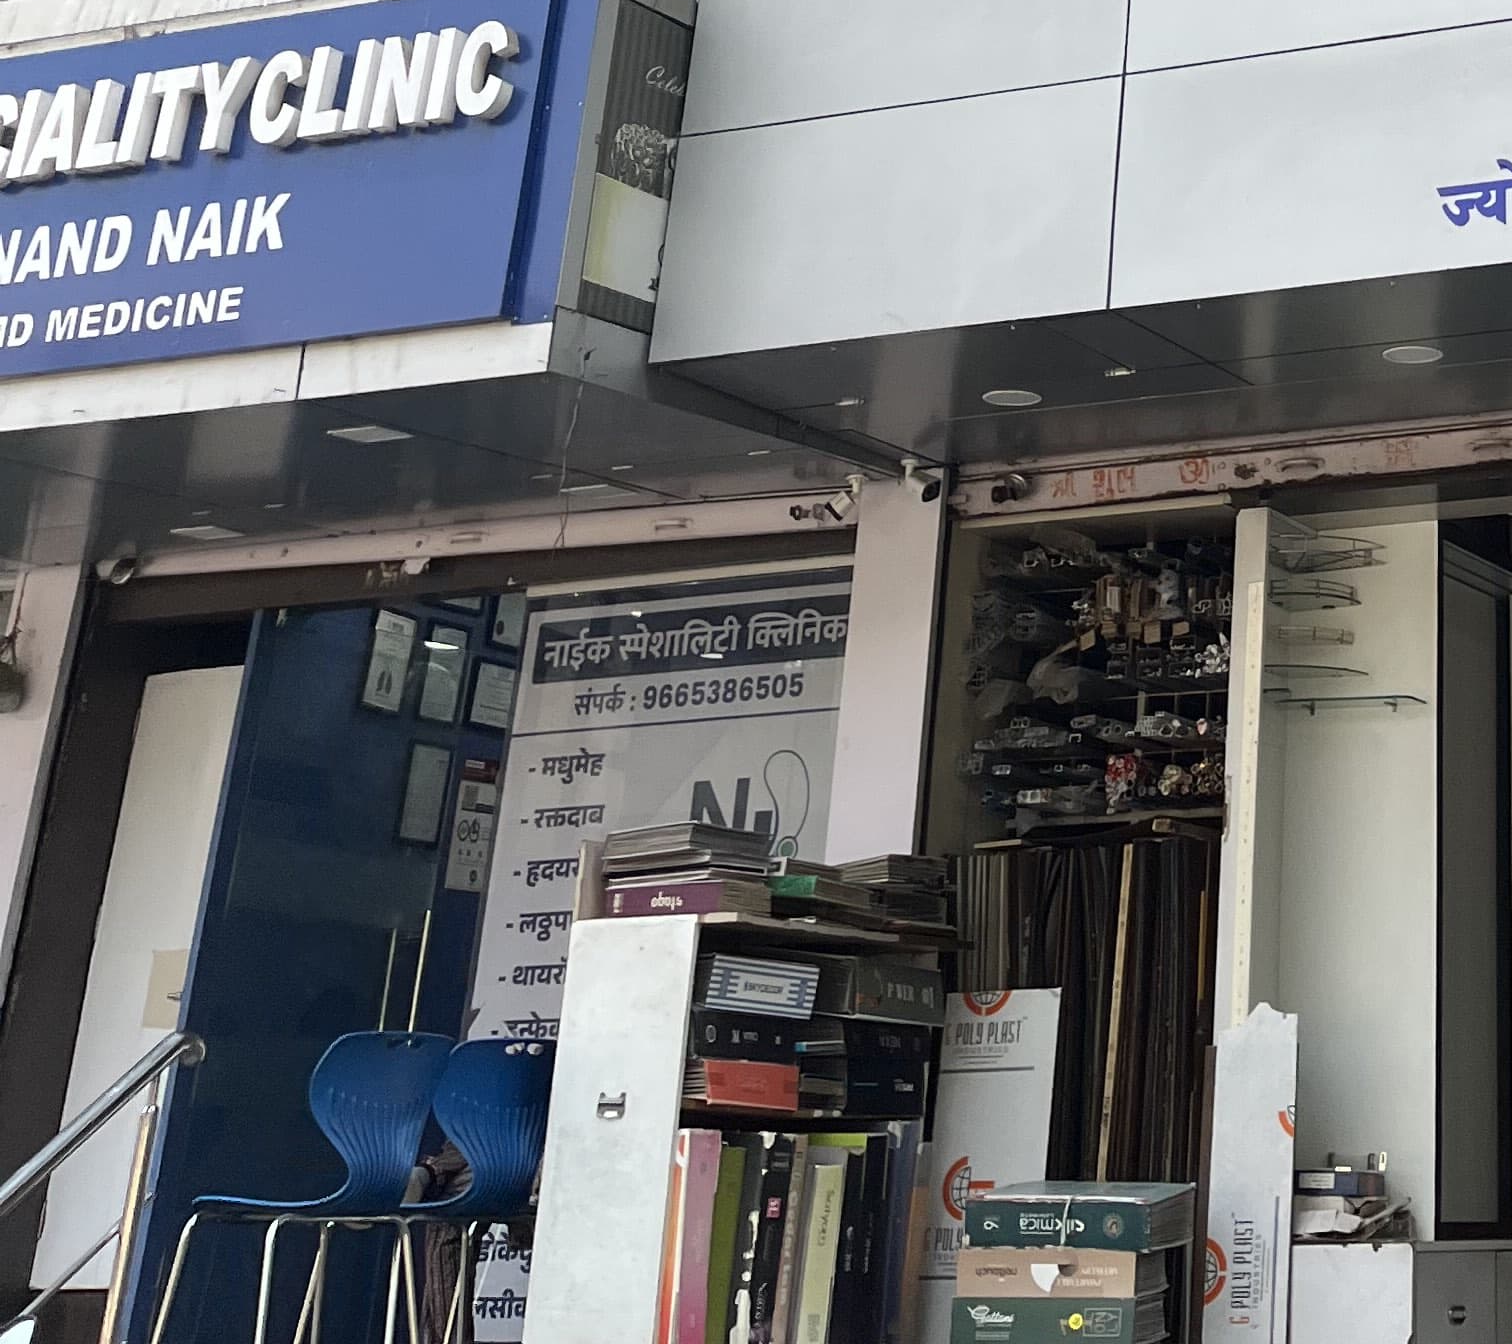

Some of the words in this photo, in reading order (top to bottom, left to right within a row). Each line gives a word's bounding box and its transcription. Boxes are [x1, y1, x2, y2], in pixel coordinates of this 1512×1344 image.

[146, 192, 292, 268] NAIK
[44, 285, 245, 344] MEDICINE
[543, 626, 615, 672] नाईक
[617, 614, 743, 663] स्पेशालिटी
[745, 607, 850, 652] क्लिनिक
[573, 682, 627, 716] संपर्क
[642, 671, 805, 711] 9665386505
[540, 746, 606, 785] मधुमेह
